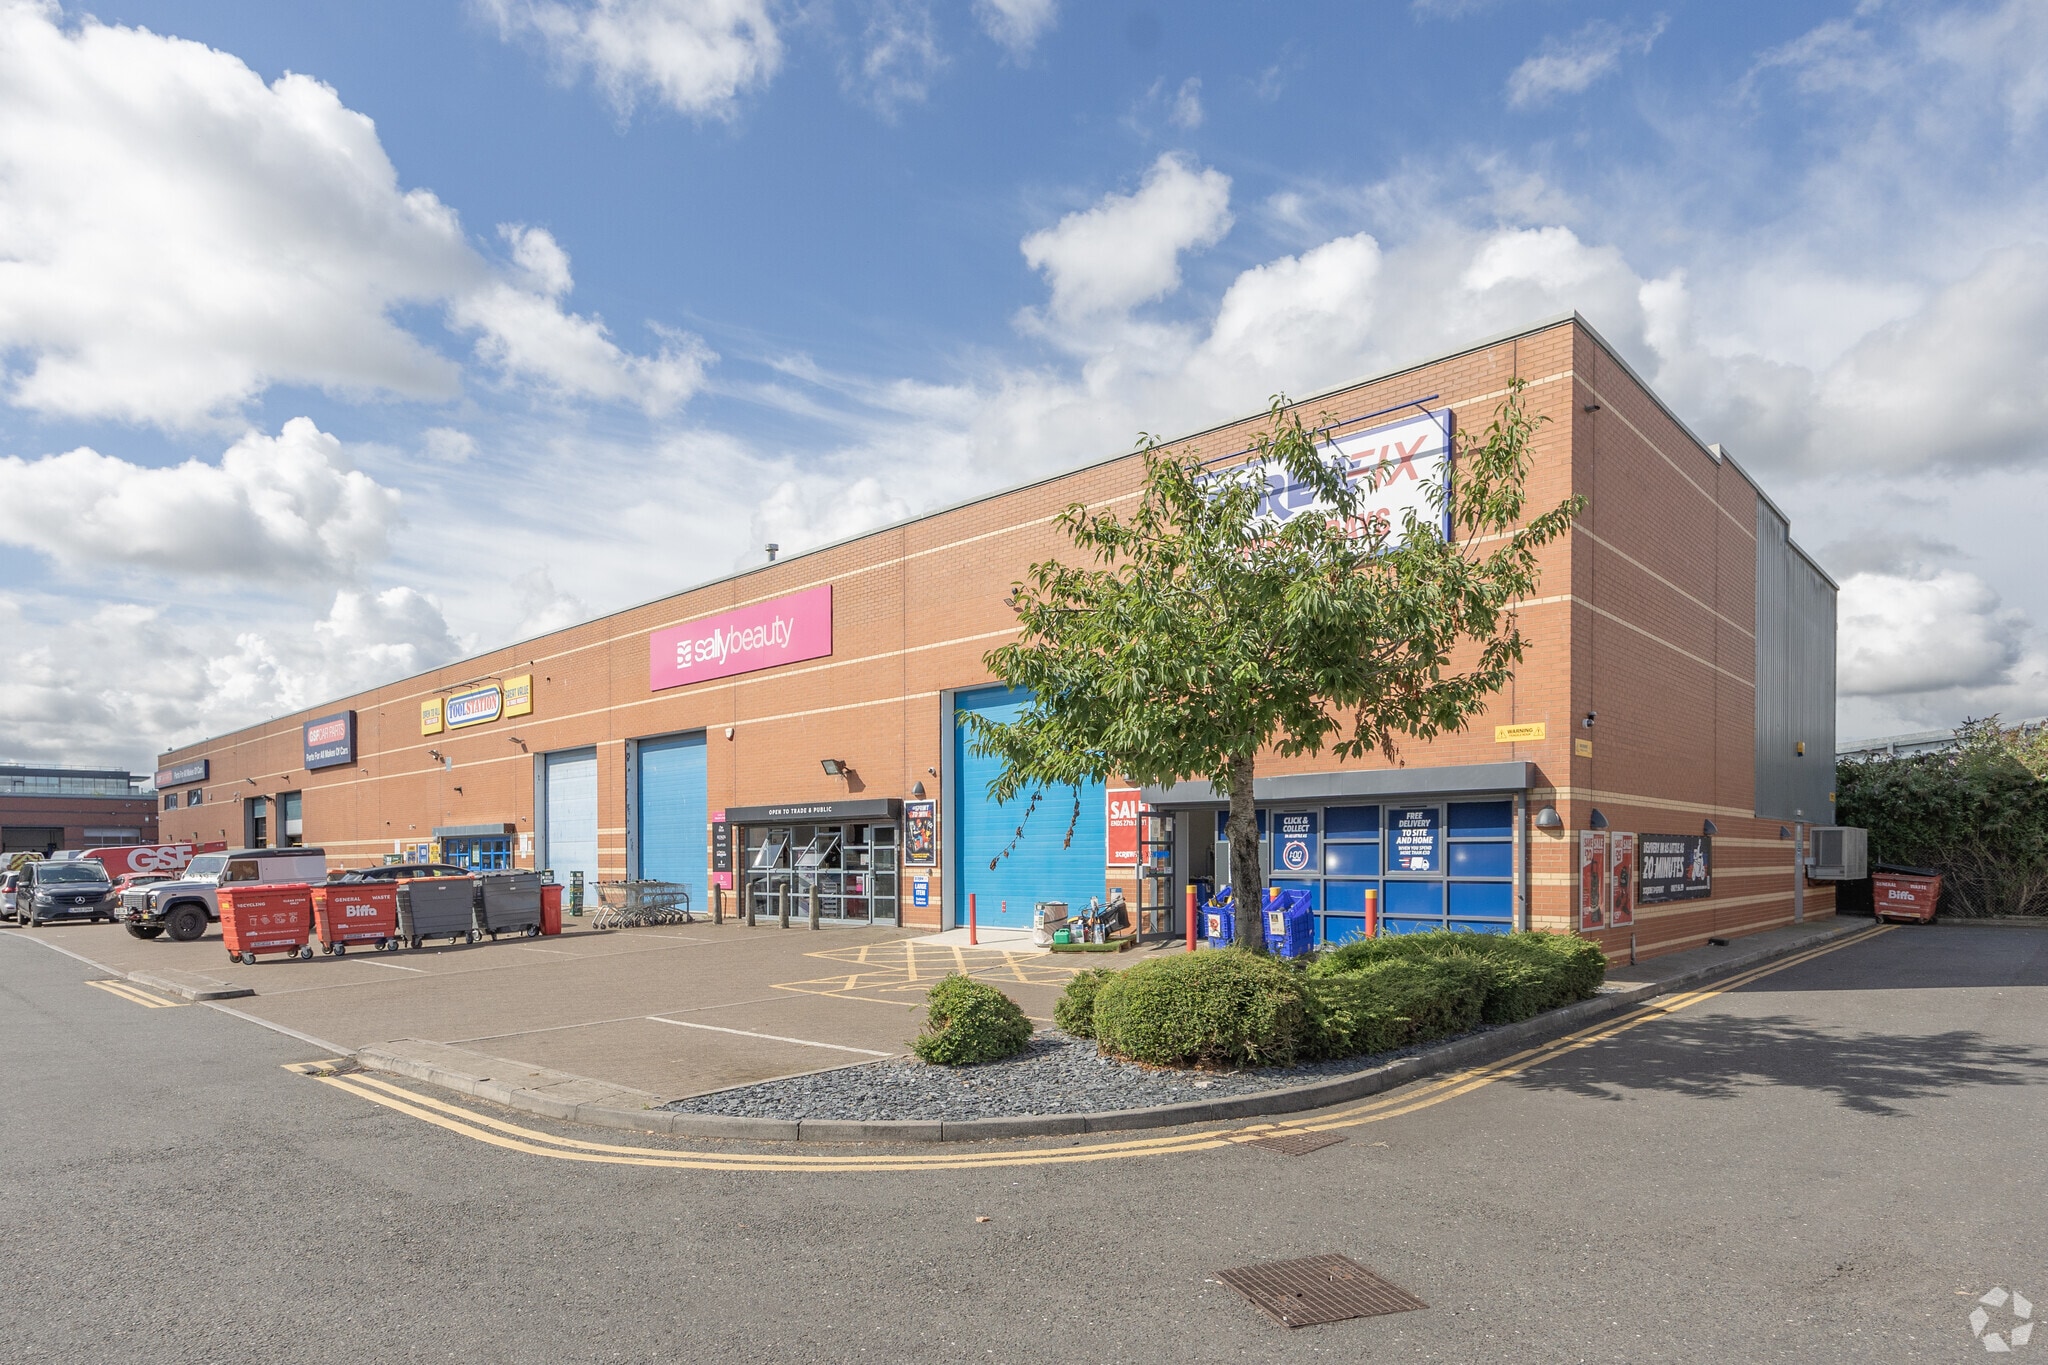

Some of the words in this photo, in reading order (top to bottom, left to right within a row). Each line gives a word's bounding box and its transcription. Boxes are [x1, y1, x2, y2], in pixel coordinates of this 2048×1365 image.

[694, 615, 794, 665] sallybeauty
[449, 694, 497, 719] TOOLSTATION
[1507, 727, 1533, 735] WARNING
[1302, 816, 1309, 824] &
[1406, 812, 1423, 820] FREE
[1399, 819, 1431, 828] DELIVERY
[1412, 836, 1434, 844] HOME
[1593, 838, 1604, 849] SALE
[1623, 840, 1632, 849] SALE
[127, 845, 193, 872] GSF
[1643, 856, 1654, 879] 20
[1654, 856, 1685, 878] MINUTES
[1888, 890, 1915, 901] Biffa
[346, 904, 377, 917] Biffa
